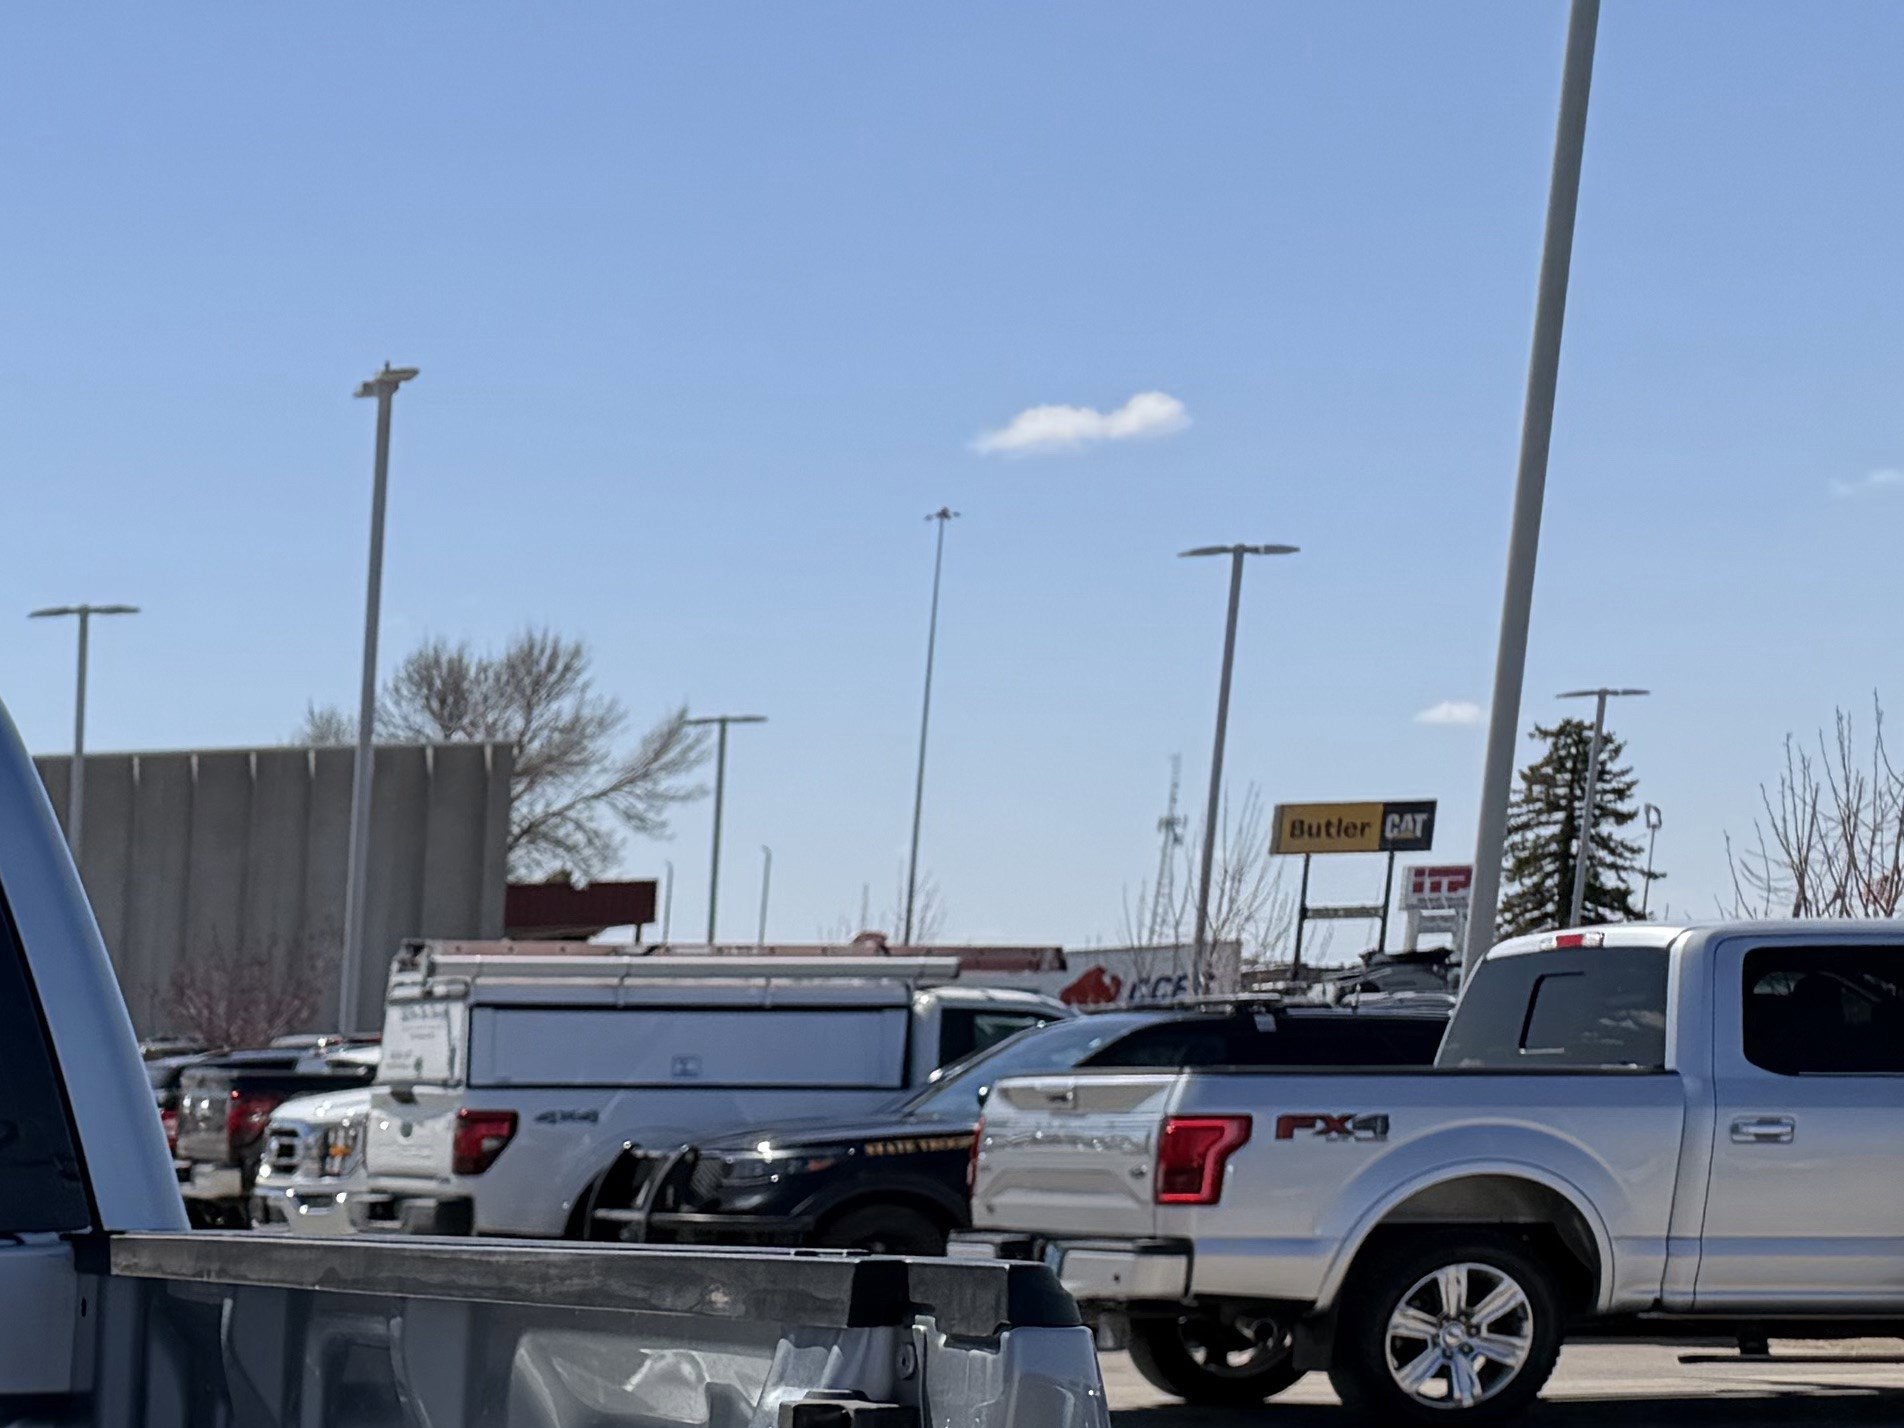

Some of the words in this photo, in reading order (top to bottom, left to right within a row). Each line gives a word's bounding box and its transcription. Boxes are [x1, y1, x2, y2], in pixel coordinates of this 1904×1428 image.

[1289, 817, 1372, 840] Butler
[1384, 812, 1428, 839] CAT
[1275, 1113, 1390, 1142] FX4
